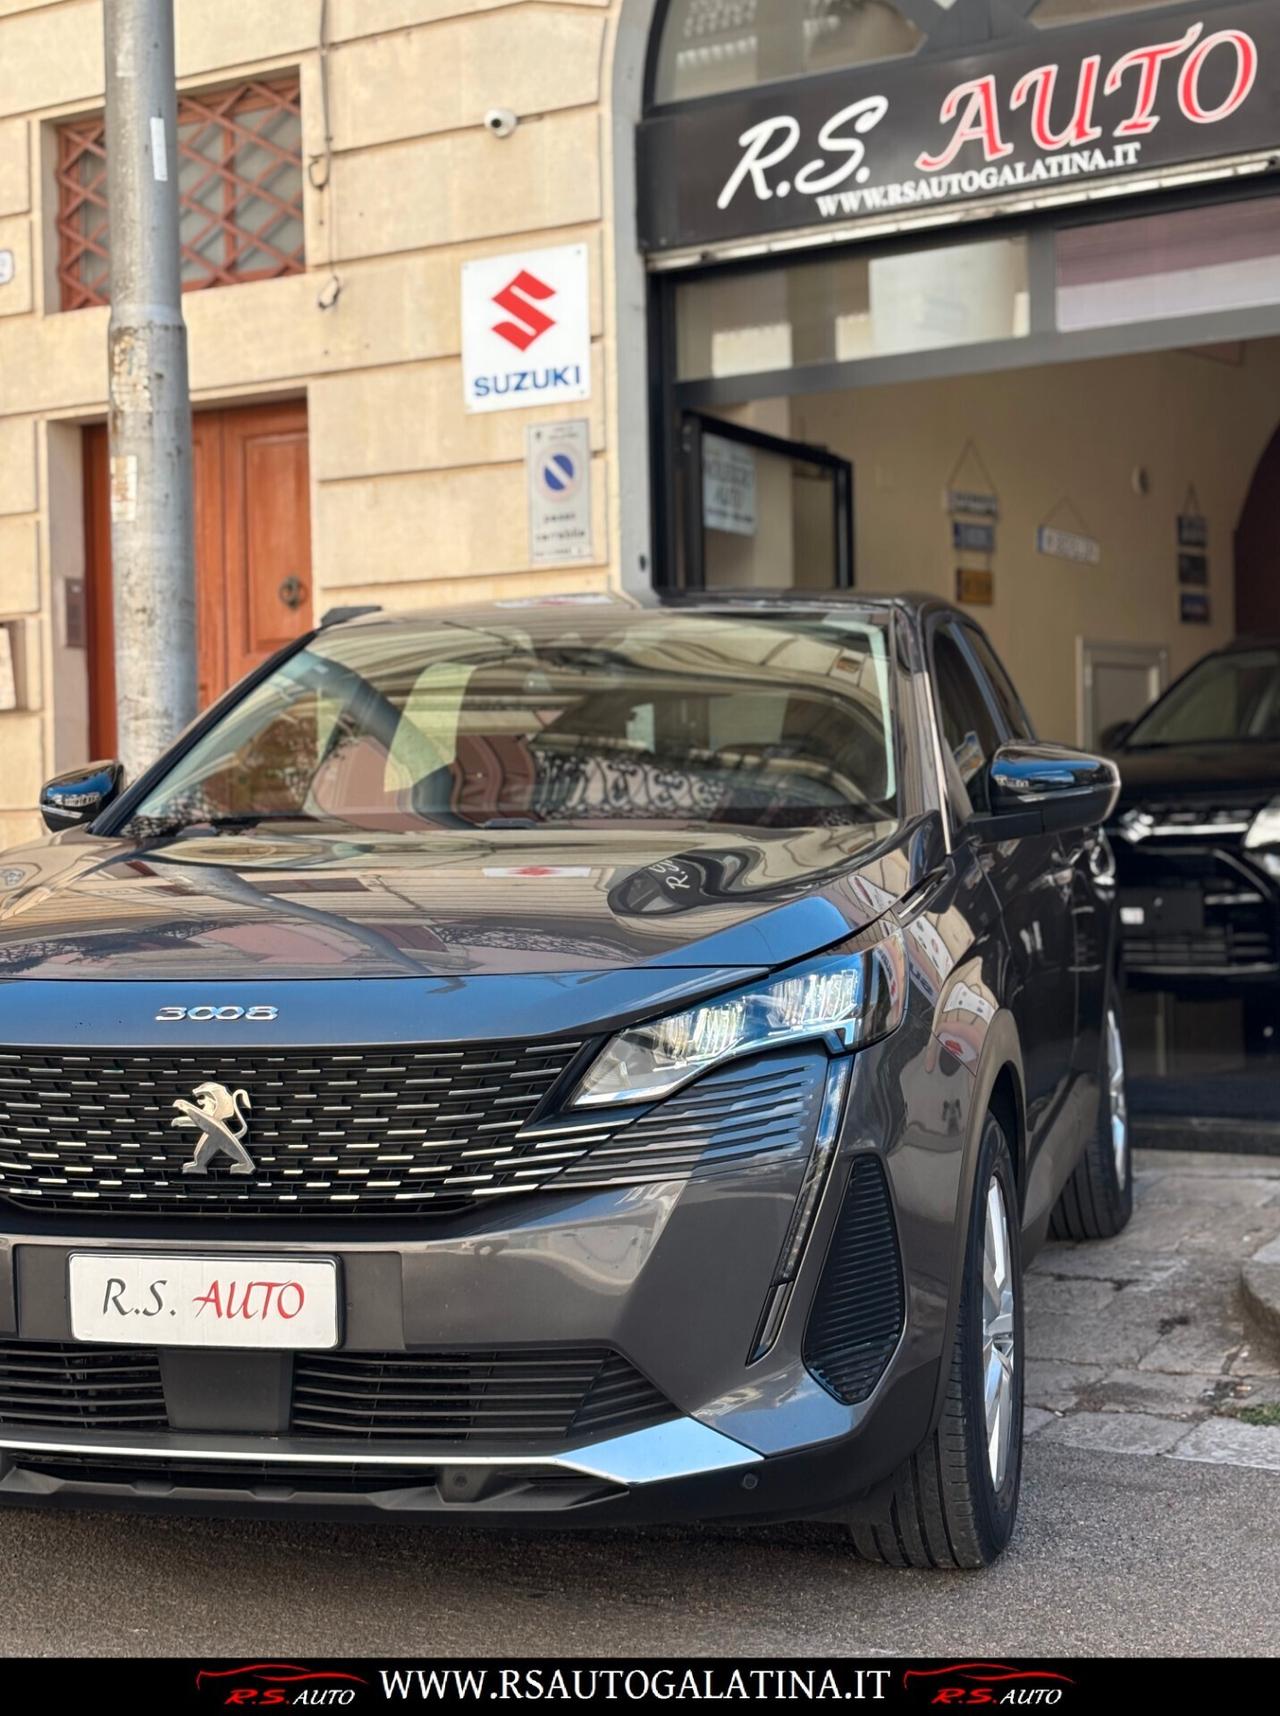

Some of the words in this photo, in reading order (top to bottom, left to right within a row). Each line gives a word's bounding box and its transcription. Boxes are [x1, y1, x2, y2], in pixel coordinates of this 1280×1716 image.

[717, 95, 889, 209] R.S.
[915, 22, 1257, 171] AUTO
[815, 142, 1141, 217] WWW.RSAUTOGALATINA.IT
[473, 365, 580, 396] SUZUKI
[155, 1006, 279, 1021] 3008
[103, 1278, 176, 1316] R.S.
[192, 1280, 305, 1320] AUTO
